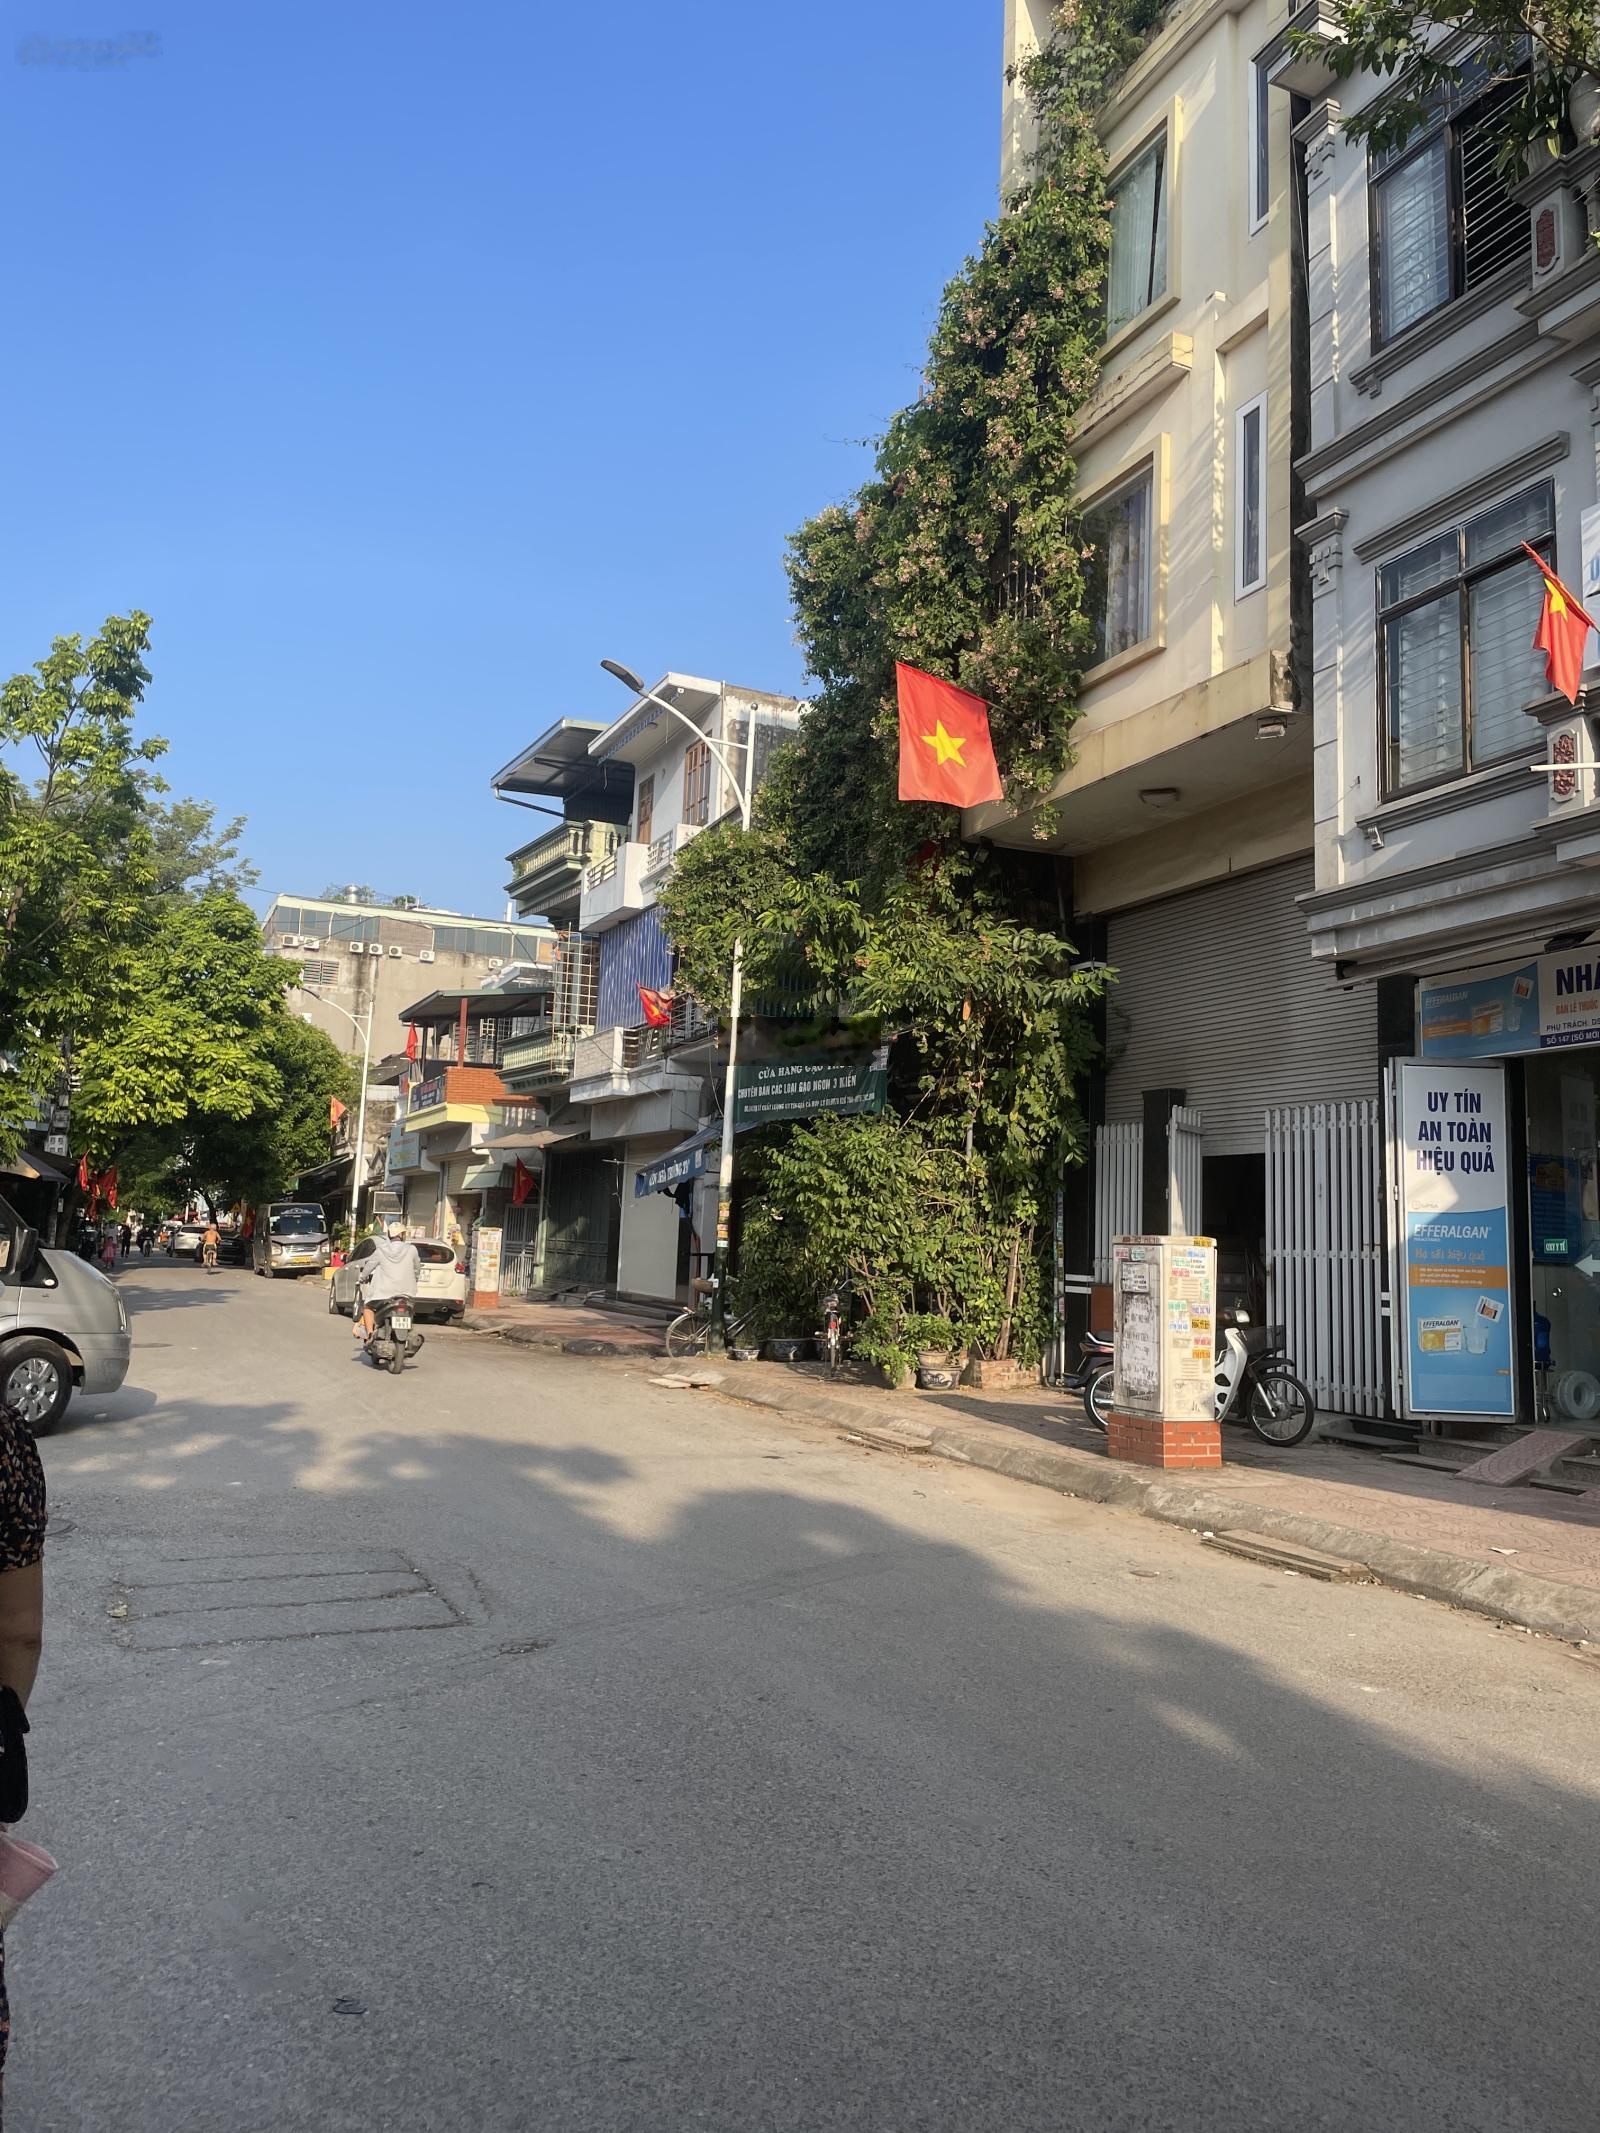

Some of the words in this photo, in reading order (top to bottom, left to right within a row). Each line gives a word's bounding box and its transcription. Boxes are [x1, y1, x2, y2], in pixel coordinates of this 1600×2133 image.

[1427, 1091, 1449, 1113] UY
[1453, 1088, 1481, 1113] TÍN
[1418, 1121, 1442, 1141] AN
[1447, 1118, 1492, 1143] TOÀN
[1416, 1146, 1455, 1175] HIỆU
[1460, 1145, 1495, 1174] QUẢ
[1414, 1224, 1489, 1239] EFFERALGAN
